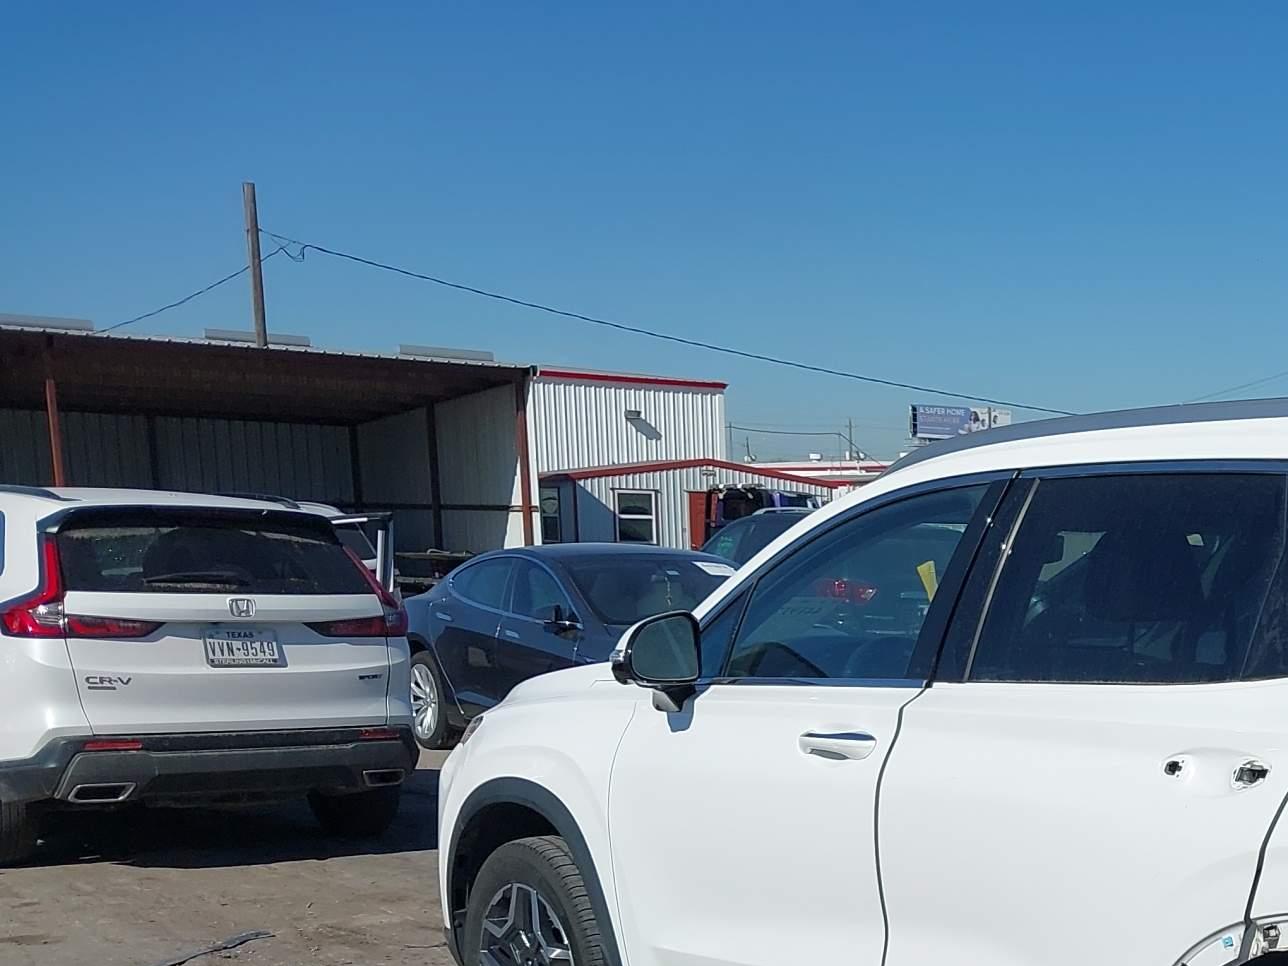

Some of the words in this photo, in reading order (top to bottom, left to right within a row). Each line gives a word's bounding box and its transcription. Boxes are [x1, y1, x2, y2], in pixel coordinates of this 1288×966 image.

[926, 407, 945, 416] SAFER
[226, 631, 254, 639] TEXAS
[85, 676, 132, 686] CR-V
